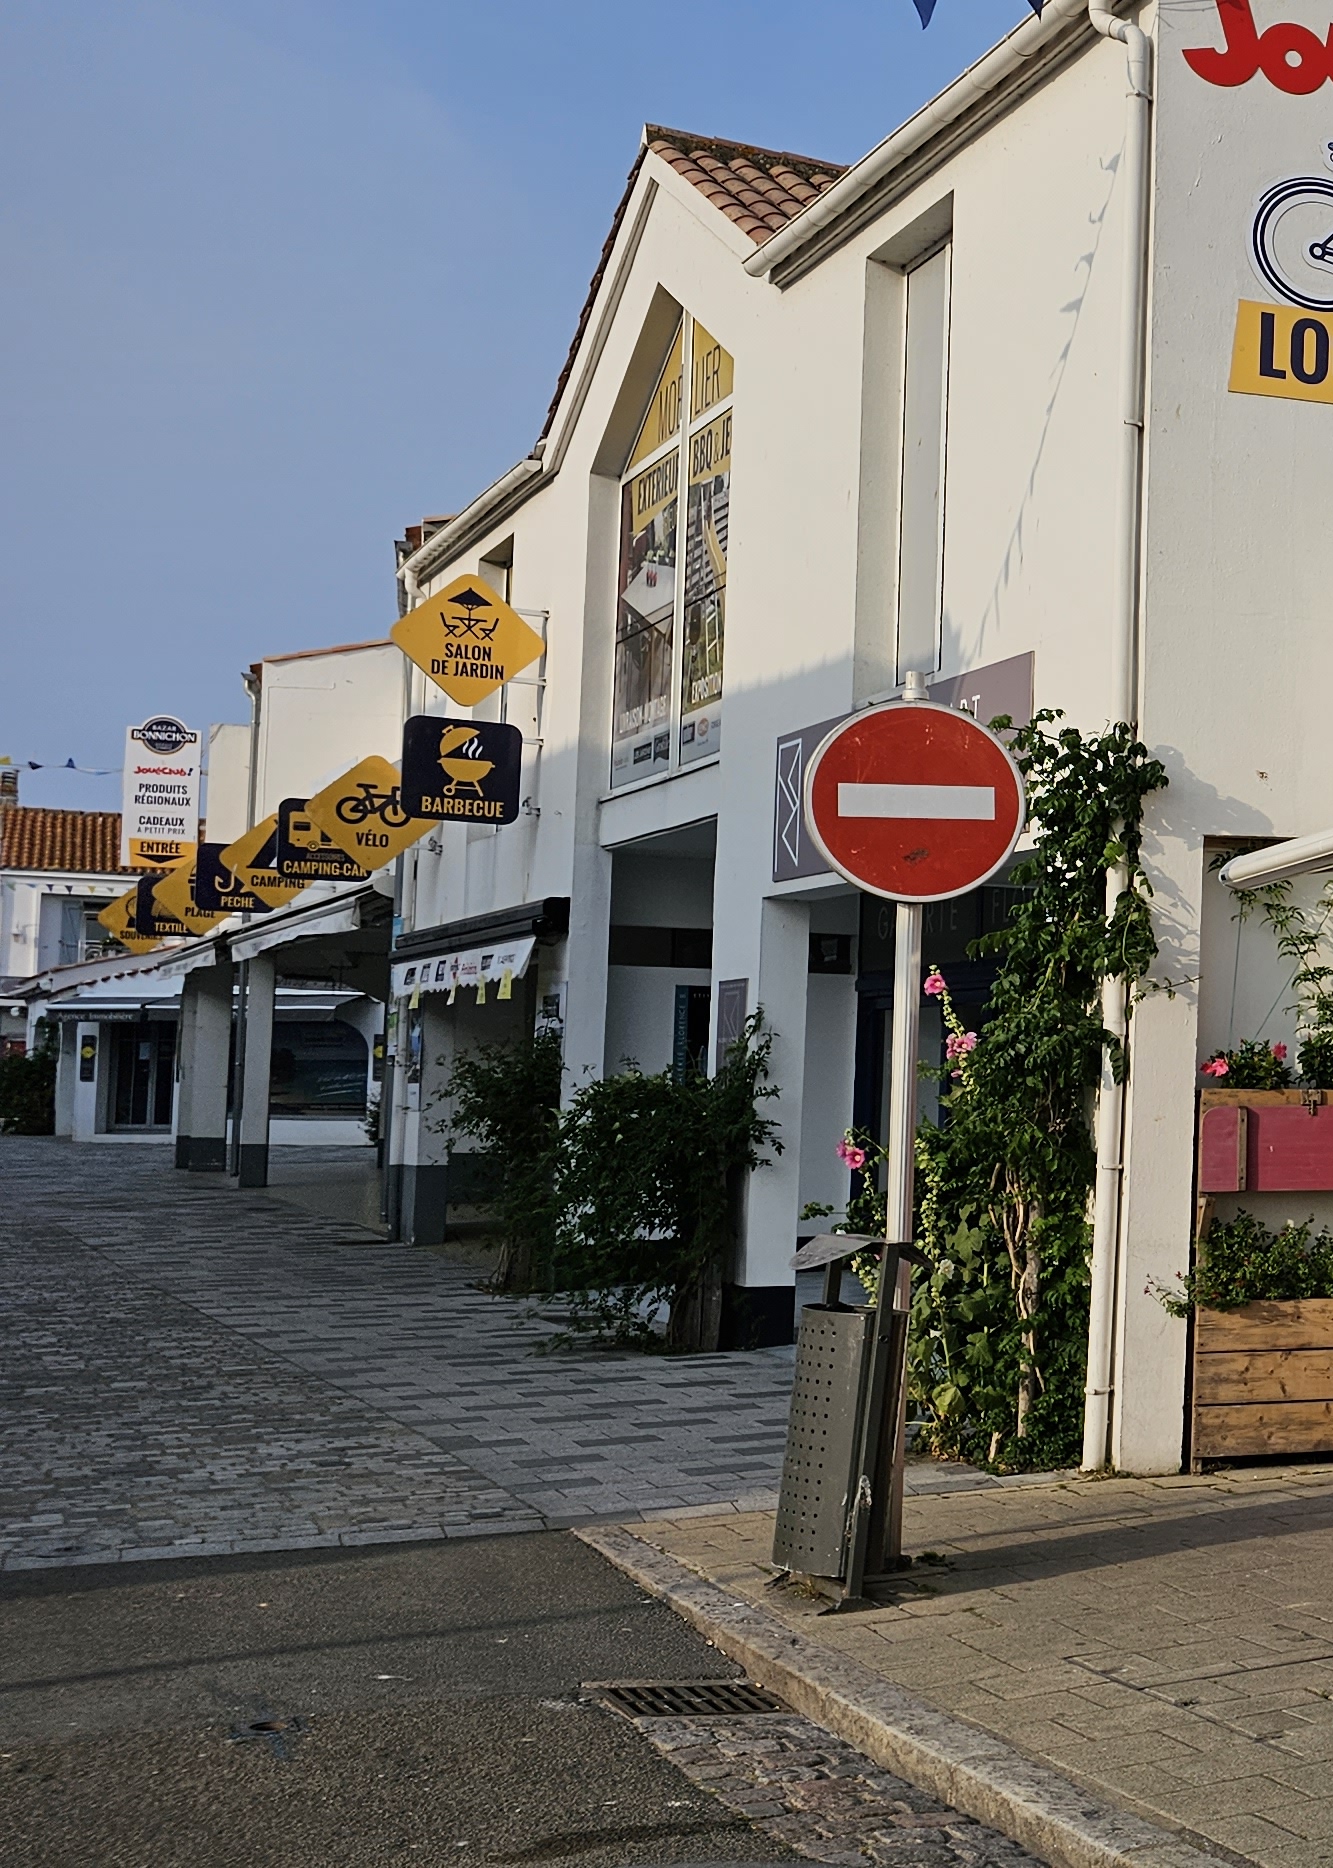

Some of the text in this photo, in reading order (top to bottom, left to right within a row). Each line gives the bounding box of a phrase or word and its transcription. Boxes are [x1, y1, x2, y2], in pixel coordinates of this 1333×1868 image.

[693, 428, 712, 478] BBQ
[714, 432, 719, 463] &
[445, 642, 492, 661] SALON
[431, 659, 504, 680] DE JARDIN
[133, 730, 196, 742] BONNICHON
[138, 783, 188, 795] PRODUITS
[134, 792, 191, 806] RÉGIONAUX
[421, 796, 504, 817] BARBECUE
[138, 815, 185, 827] CADEAUX
[167, 827, 186, 835] PRIX
[356, 829, 389, 848] VÉLO
[140, 840, 181, 854] ENTRÉE
[283, 860, 367, 877] CAMPING-CAR
[251, 875, 305, 889] CAMPING
[220, 896, 255, 909] PECHE
[184, 906, 216, 919] PLAGE
[58, 1011, 86, 1022] Agence
